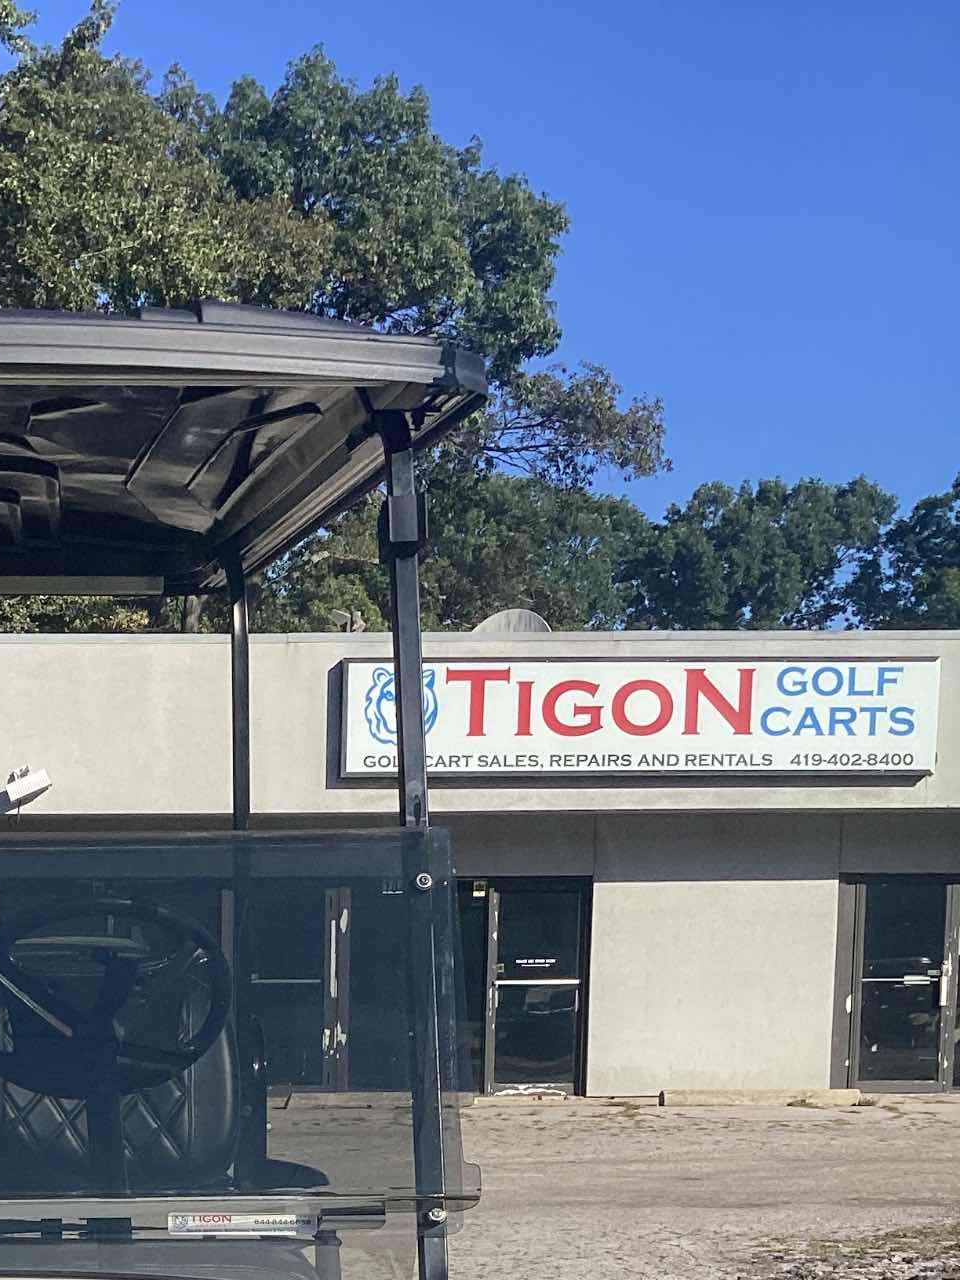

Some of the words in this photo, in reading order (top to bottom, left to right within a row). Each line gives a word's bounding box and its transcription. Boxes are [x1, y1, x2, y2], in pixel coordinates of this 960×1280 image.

[776, 666, 904, 697] GOLF
[446, 666, 757, 737] TIGON
[759, 706, 915, 737] CARTS
[362, 755, 400, 768] GOL
[424, 755, 473, 768] CART
[477, 754, 544, 770] SALES,
[549, 754, 632, 768] REPAIRS
[637, 754, 680, 767] AND
[684, 753, 774, 767] RENTALS
[790, 753, 915, 767] 419-402-8400
